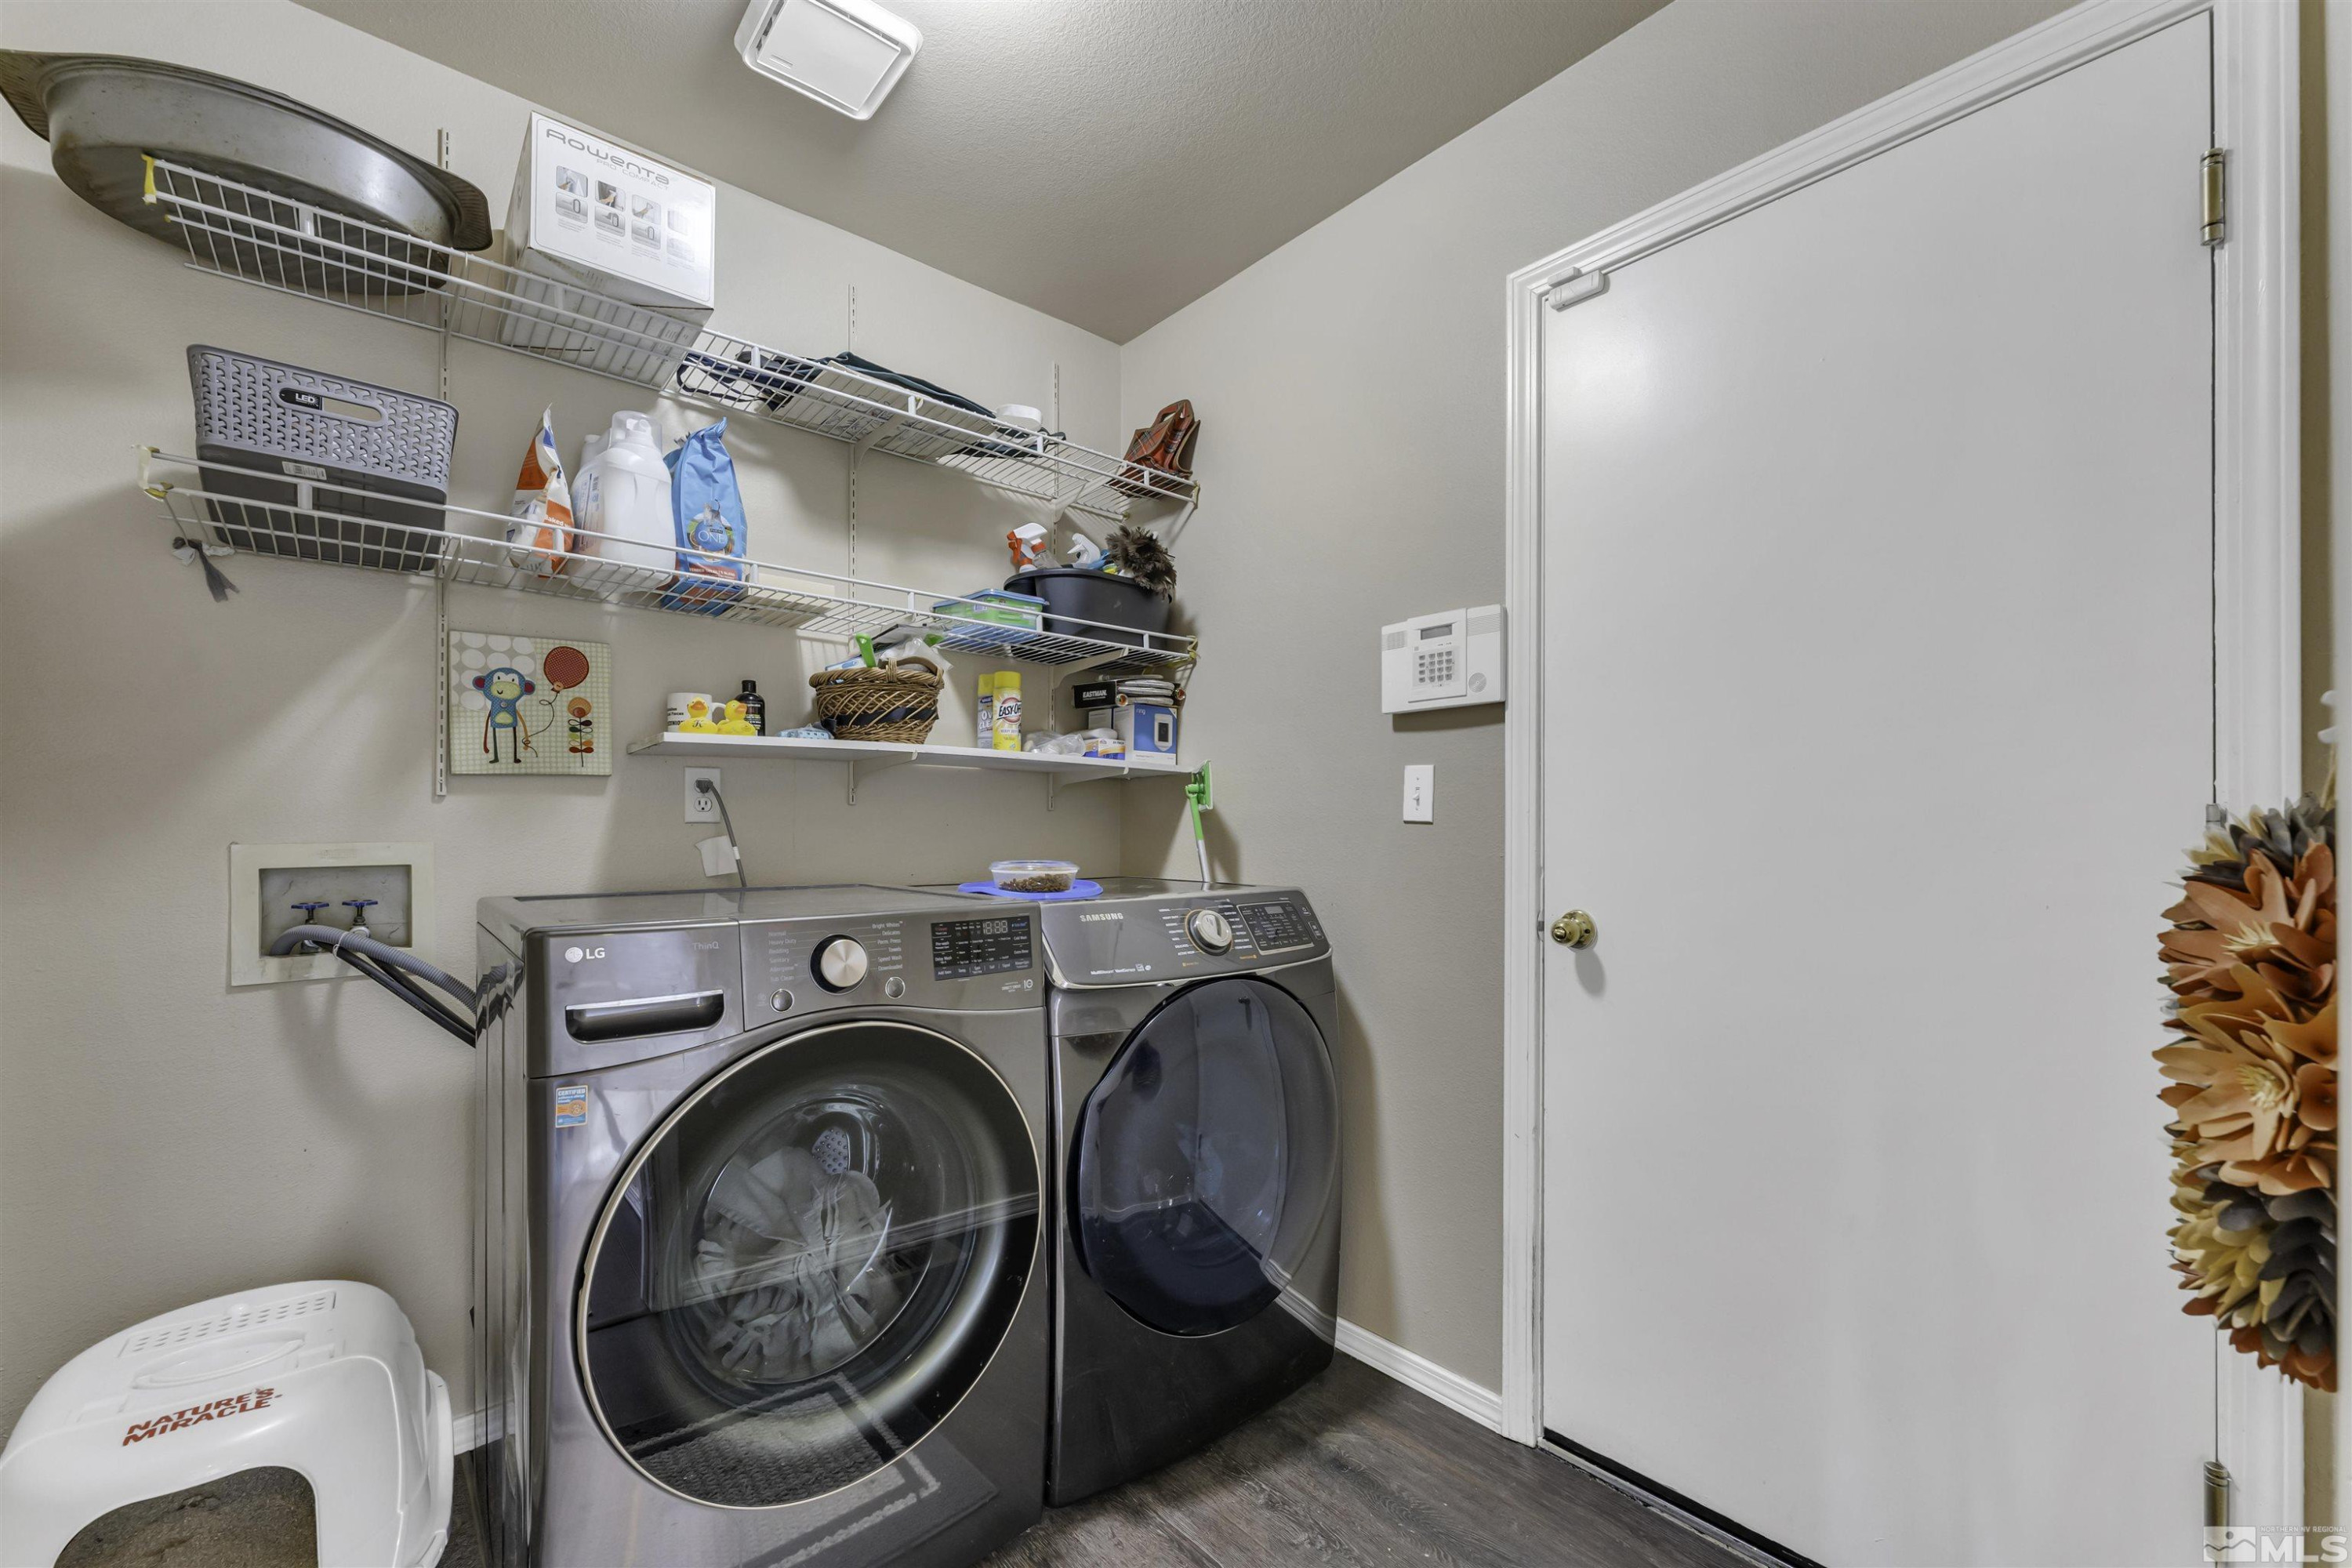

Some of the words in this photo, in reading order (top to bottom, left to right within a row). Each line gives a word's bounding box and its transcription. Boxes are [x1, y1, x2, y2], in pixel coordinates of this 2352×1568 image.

[597, 158, 617, 171] PRO
[296, 393, 315, 403] LED
[545, 514, 564, 526] Baked
[699, 530, 725, 544] ONE
[1080, 912, 1124, 922] SAMSUNG
[692, 941, 719, 950] ThinQ
[586, 948, 605, 960] LG
[126, 1388, 274, 1435] NATURE'S
[122, 1396, 271, 1446] MIRACLE
